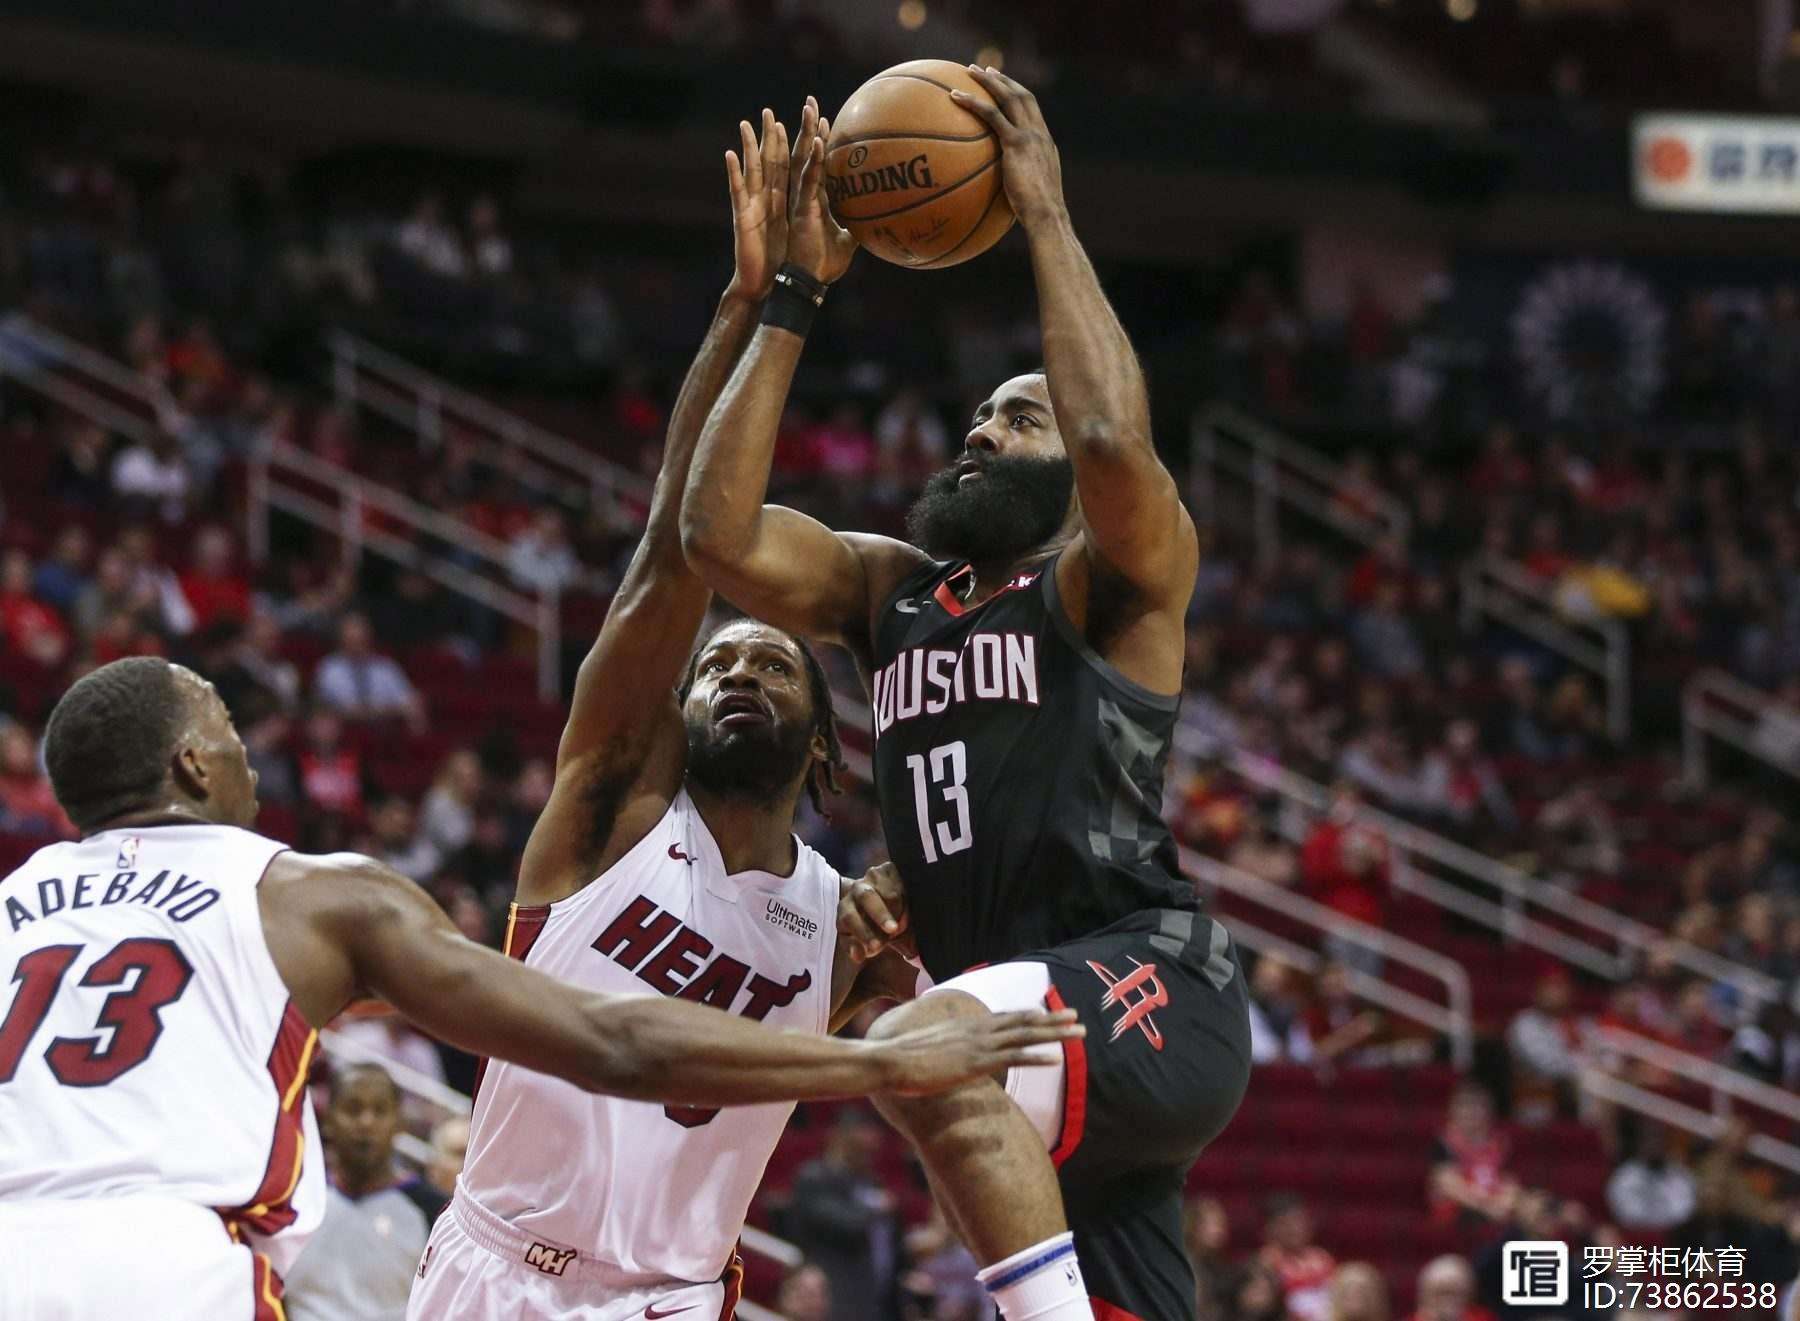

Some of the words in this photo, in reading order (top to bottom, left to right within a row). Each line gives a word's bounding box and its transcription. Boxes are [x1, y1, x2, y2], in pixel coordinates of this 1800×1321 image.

[825, 153, 933, 198] PALDING
[906, 740, 973, 864] 13
[5, 869, 221, 933] ADEBAYO
[765, 913, 814, 940] SOFTWARE
[766, 898, 818, 933] Ultimate
[590, 894, 812, 1022] HEAT
[0, 937, 195, 1088] 13
